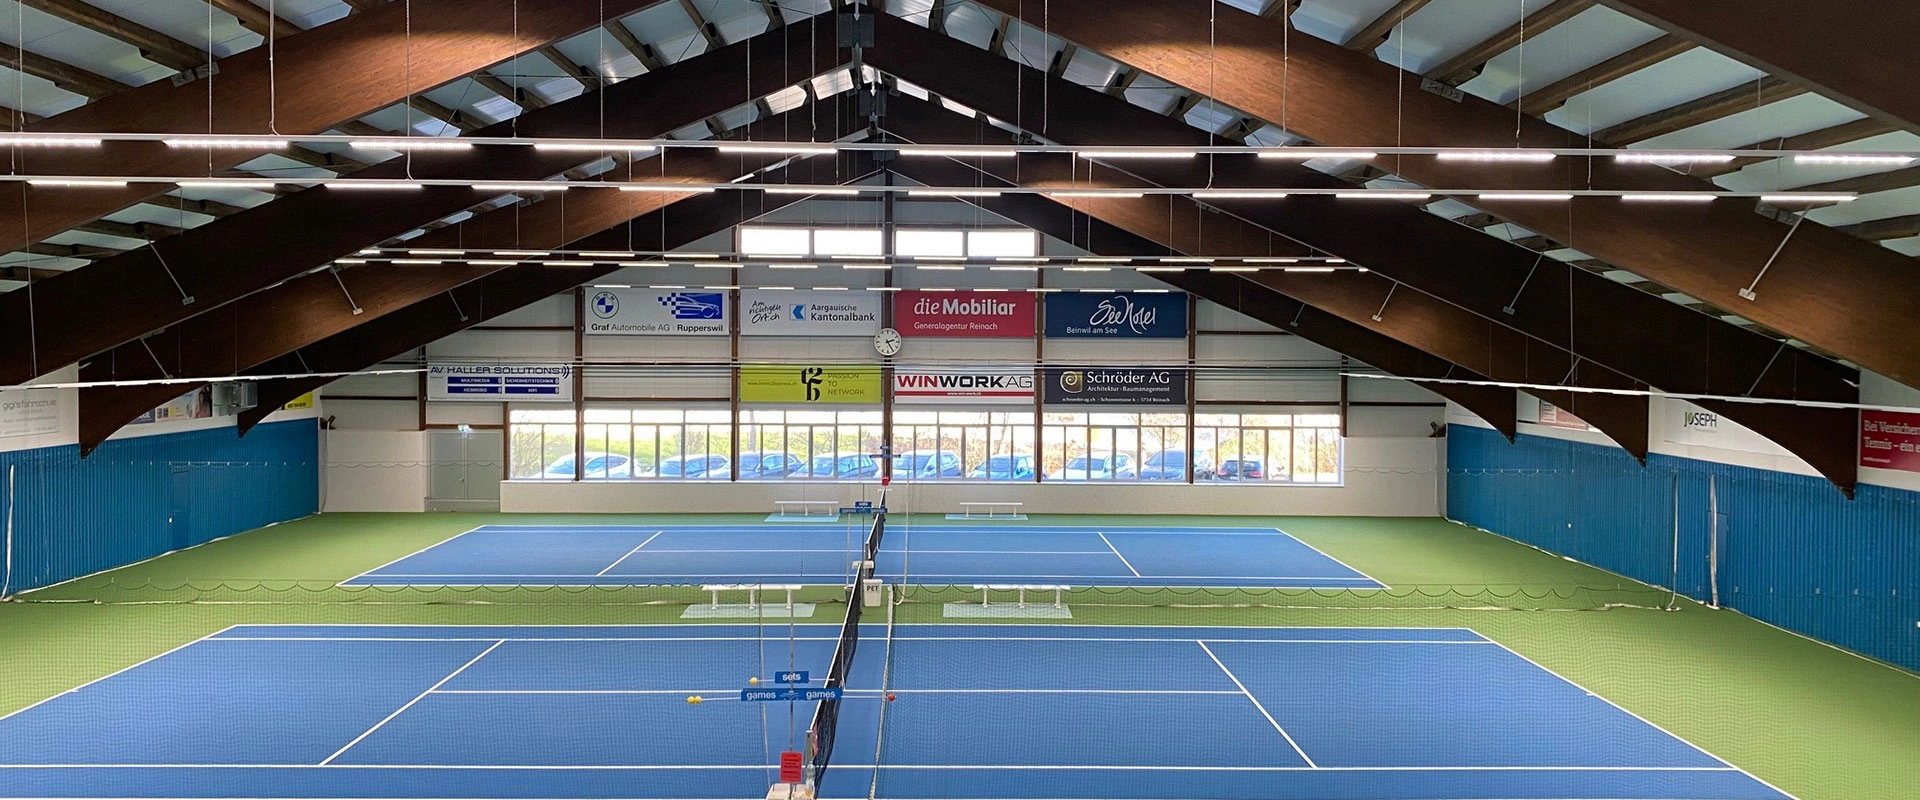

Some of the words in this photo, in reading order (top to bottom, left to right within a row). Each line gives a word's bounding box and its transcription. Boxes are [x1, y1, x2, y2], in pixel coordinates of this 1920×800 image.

[811, 304, 857, 312] Aargauische
[914, 298, 940, 315] die
[942, 299, 1016, 315] Mobiliar
[811, 313, 875, 321] Kantonalbank
[591, 323, 609, 331] Graf
[677, 324, 723, 333] Rupperswil
[914, 322, 968, 331] Generalagentur
[970, 322, 997, 330] Reinach
[1087, 371, 1145, 383] Schröder
[1149, 372, 1170, 383] AG
[1684, 412, 1717, 427] JOSEPH
[746, 692, 776, 700] games
[806, 691, 836, 699] games
